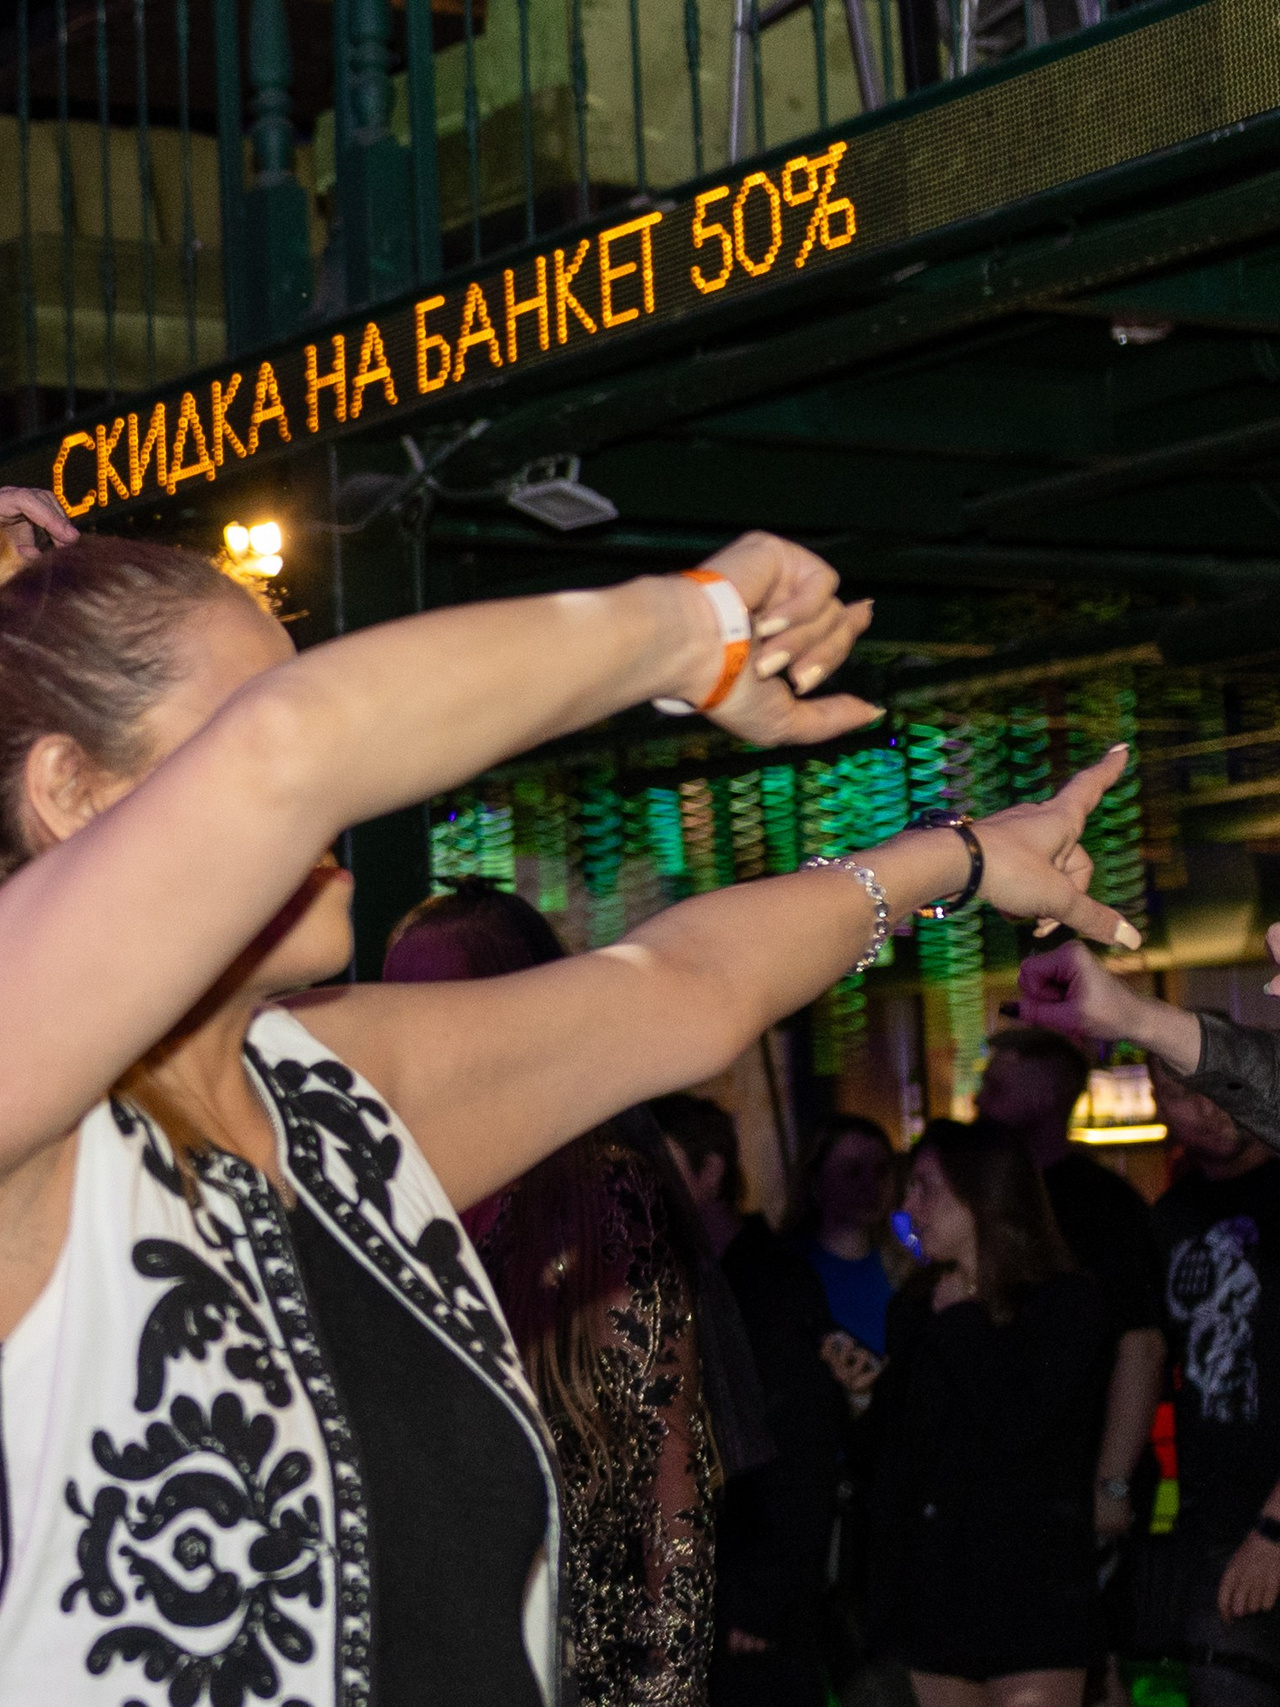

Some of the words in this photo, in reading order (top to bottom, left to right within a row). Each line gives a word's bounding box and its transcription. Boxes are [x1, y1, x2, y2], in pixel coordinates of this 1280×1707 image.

[53, 361, 292, 518] СКИДКА
[304, 321, 399, 432] НА
[414, 210, 664, 395] БАНКЕТ
[690, 140, 857, 294] 50%
